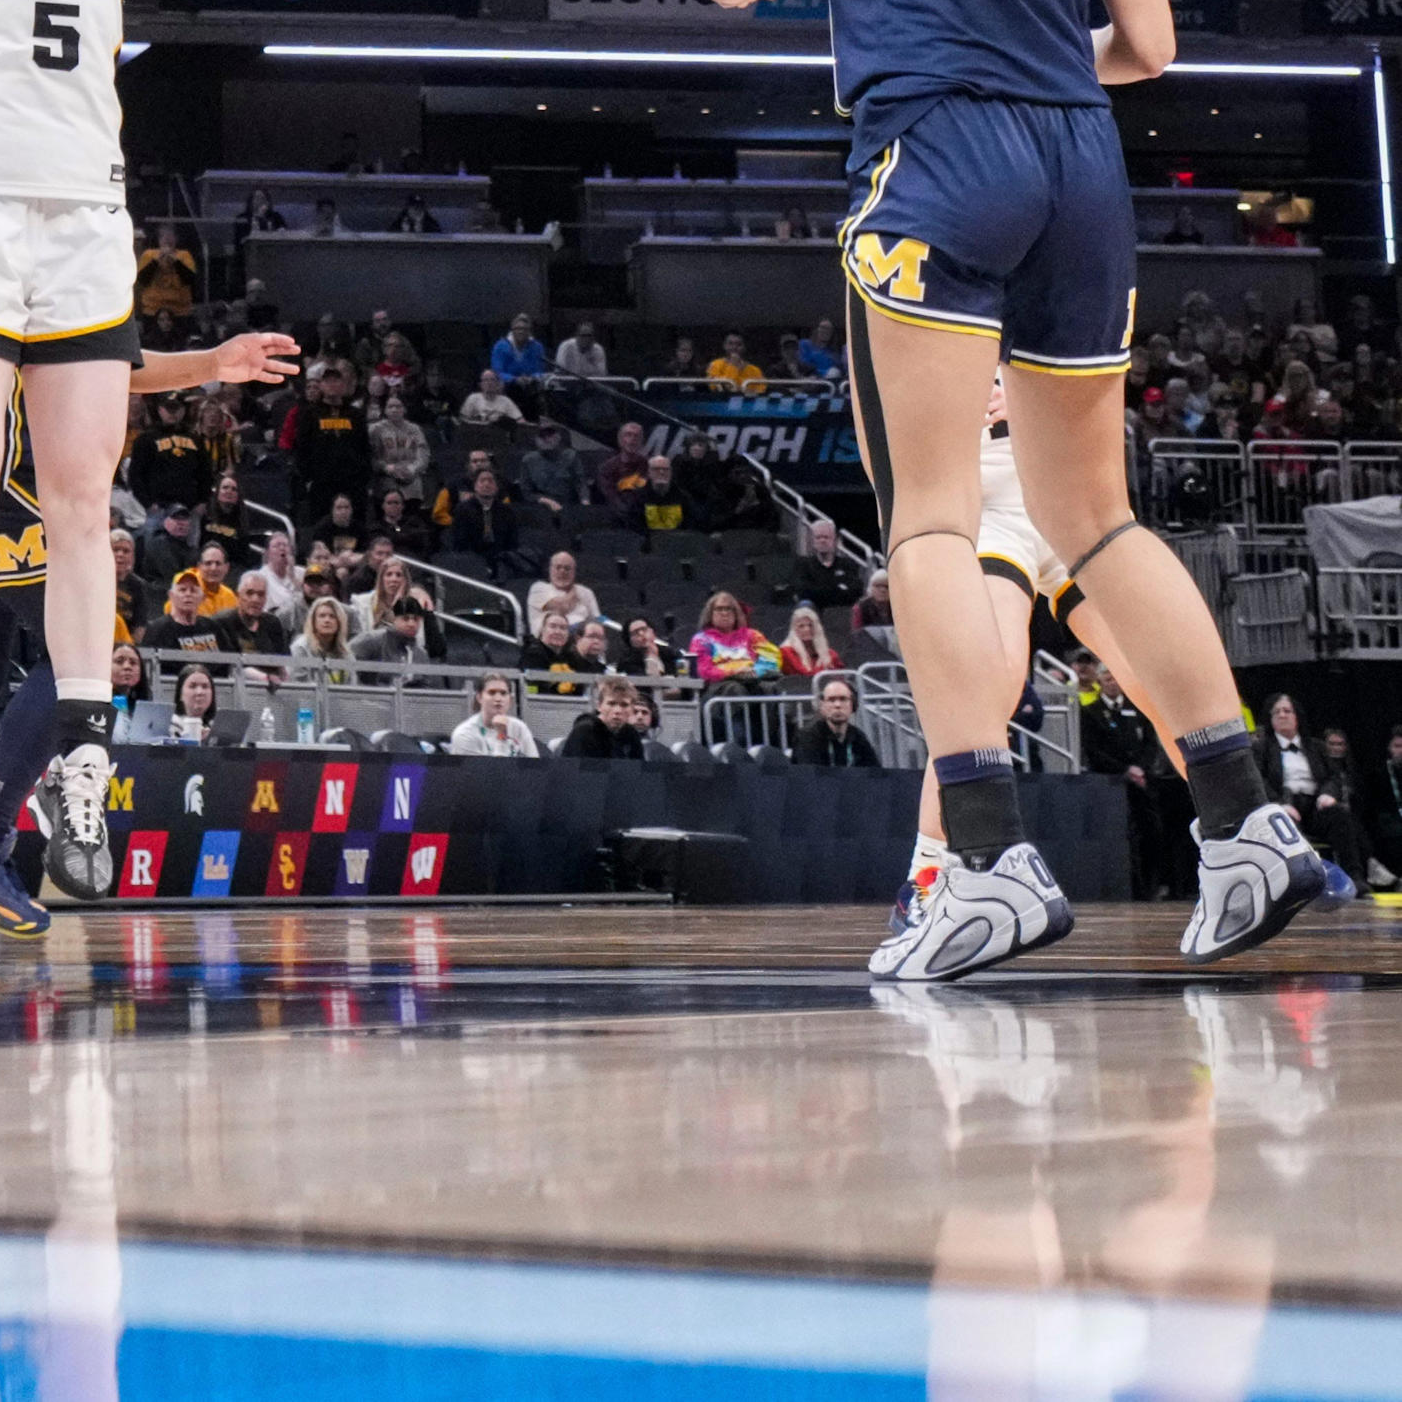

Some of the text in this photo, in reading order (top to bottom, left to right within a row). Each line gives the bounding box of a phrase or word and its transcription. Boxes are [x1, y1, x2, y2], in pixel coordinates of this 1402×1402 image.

[32, 1, 82, 71] 5
[854, 233, 931, 303] M
[130, 849, 154, 886] R
